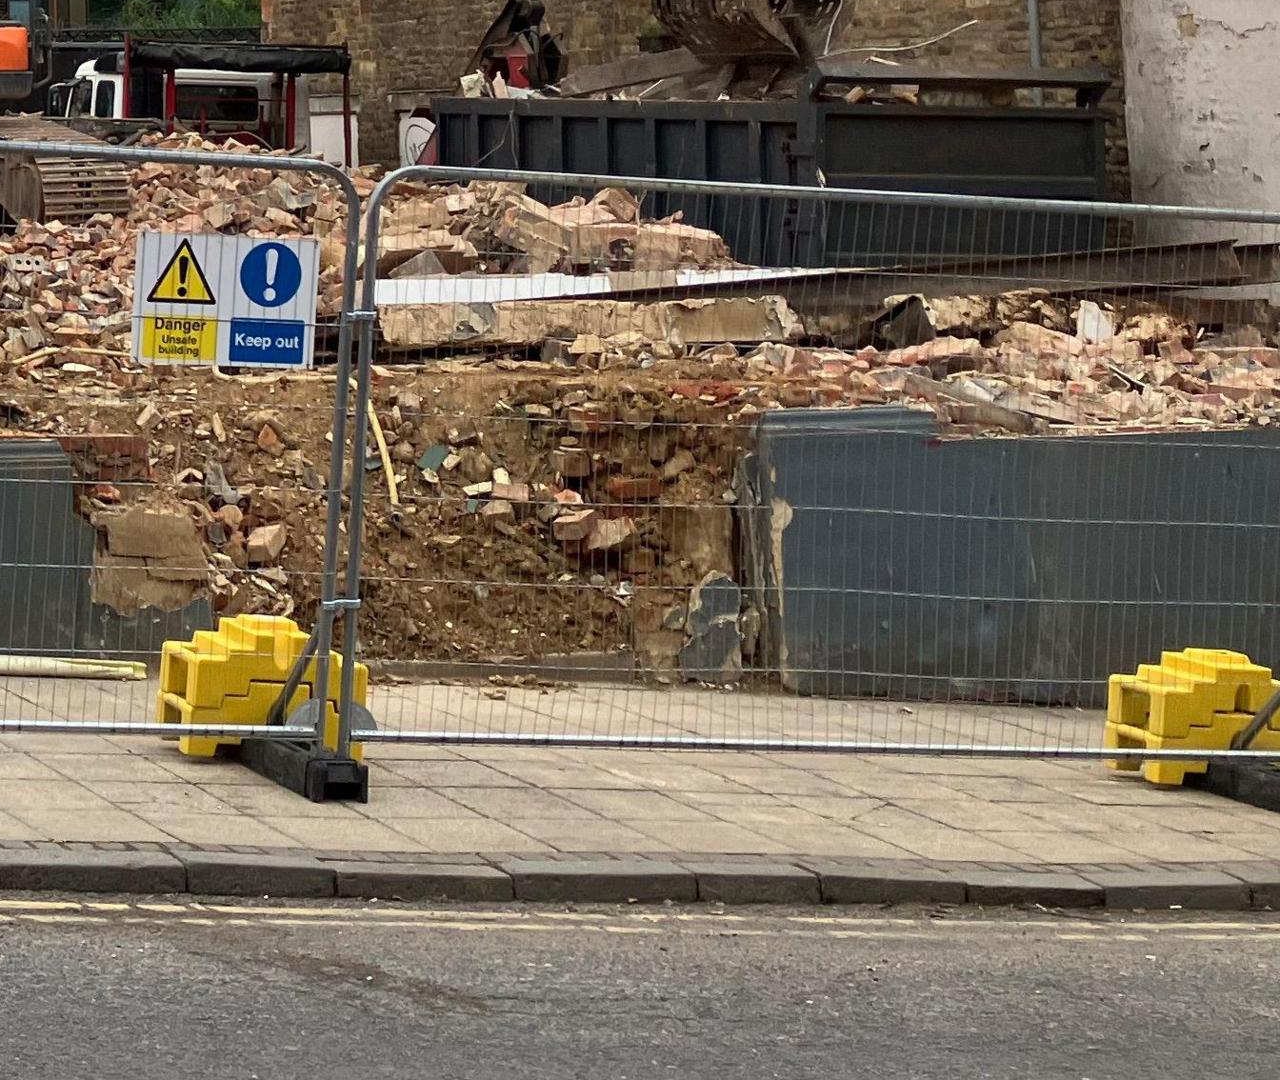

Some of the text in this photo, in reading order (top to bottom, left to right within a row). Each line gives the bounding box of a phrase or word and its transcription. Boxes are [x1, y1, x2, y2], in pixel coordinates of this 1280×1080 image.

[155, 317, 207, 334] Danger
[162, 335, 197, 345] Unsafe
[235, 333, 300, 350] Keep out
[158, 345, 200, 357] building
